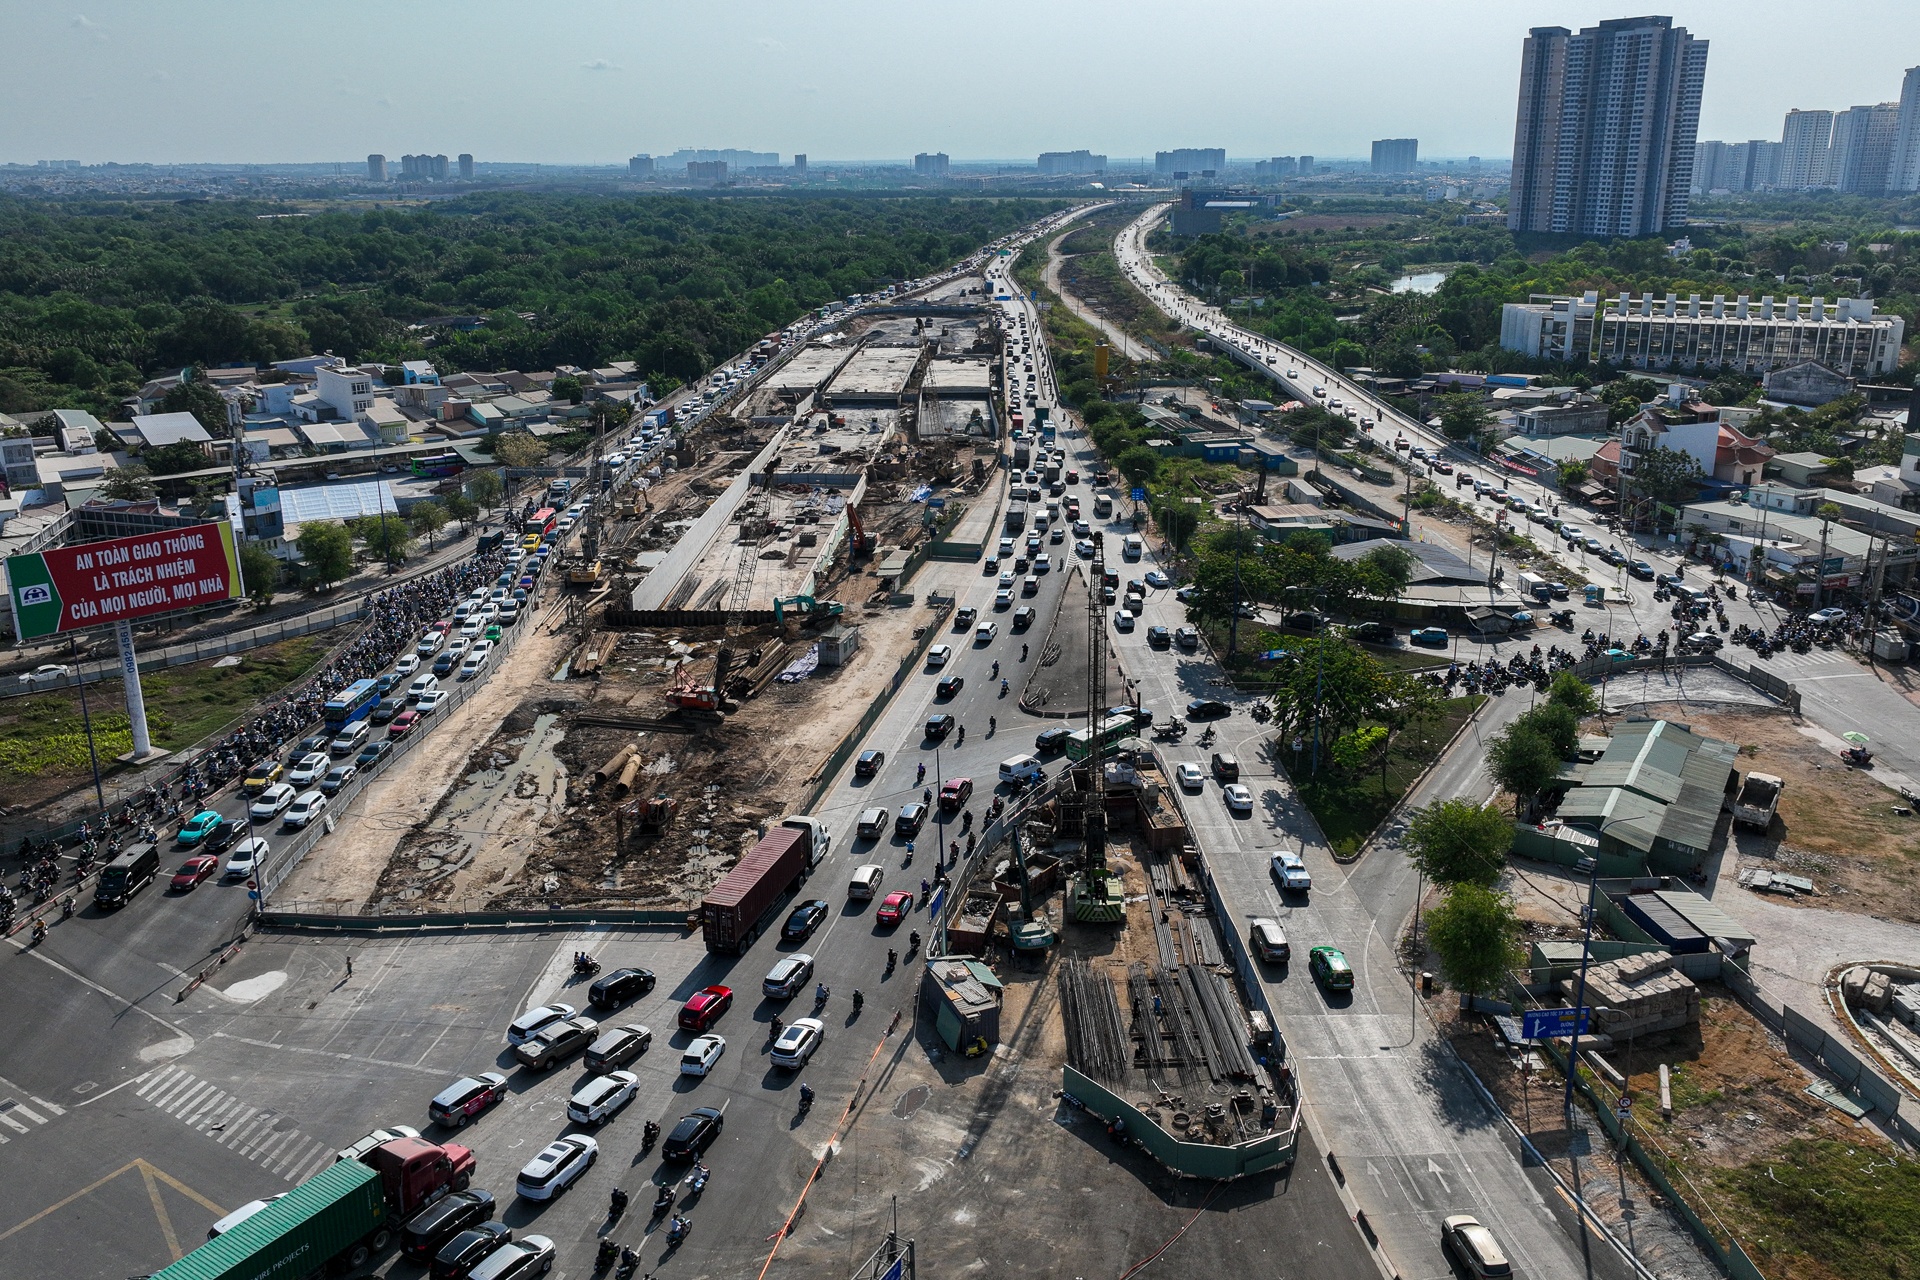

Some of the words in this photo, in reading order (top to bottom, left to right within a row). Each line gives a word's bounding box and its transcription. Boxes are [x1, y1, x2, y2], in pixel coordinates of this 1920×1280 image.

[76, 554, 94, 571] AN
[96, 544, 130, 567] TOÀN
[132, 541, 162, 561] GIAO
[163, 533, 205, 555] THÔNG
[93, 568, 109, 592] LÀ
[111, 562, 154, 587] TRÁCH
[155, 557, 195, 582] NHIỆM
[70, 597, 98, 620] CỦA
[100, 595, 127, 616] MỌI
[128, 585, 171, 609] NGƯỜI,
[173, 580, 197, 601] MỌI
[199, 573, 224, 595] NHÀ
[120, 631, 131, 649] 456
[124, 650, 135, 673] 0982
[272, 1242, 310, 1272] PROJECTS
